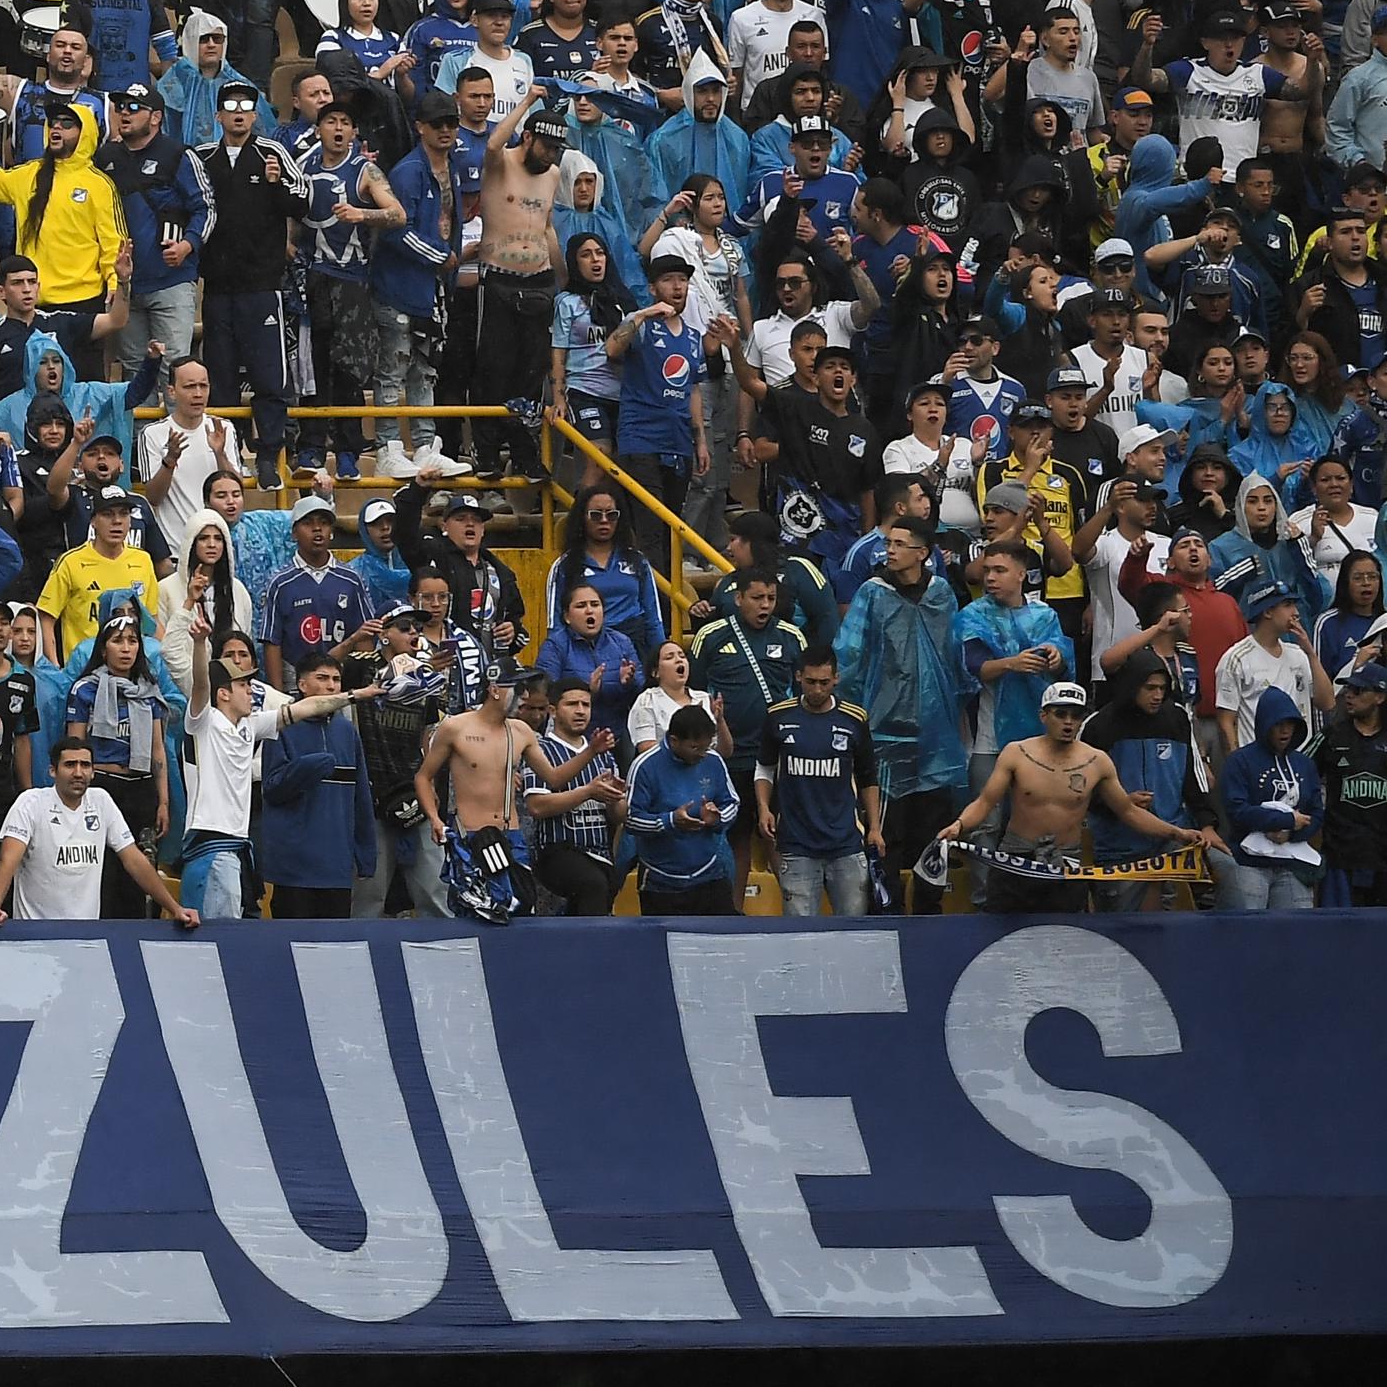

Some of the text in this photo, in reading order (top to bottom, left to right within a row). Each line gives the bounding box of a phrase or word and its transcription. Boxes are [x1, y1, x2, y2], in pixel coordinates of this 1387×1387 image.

[321, 617, 345, 643] LG
[787, 756, 840, 778] ANDINA
[55, 845, 99, 865] ANDINA
